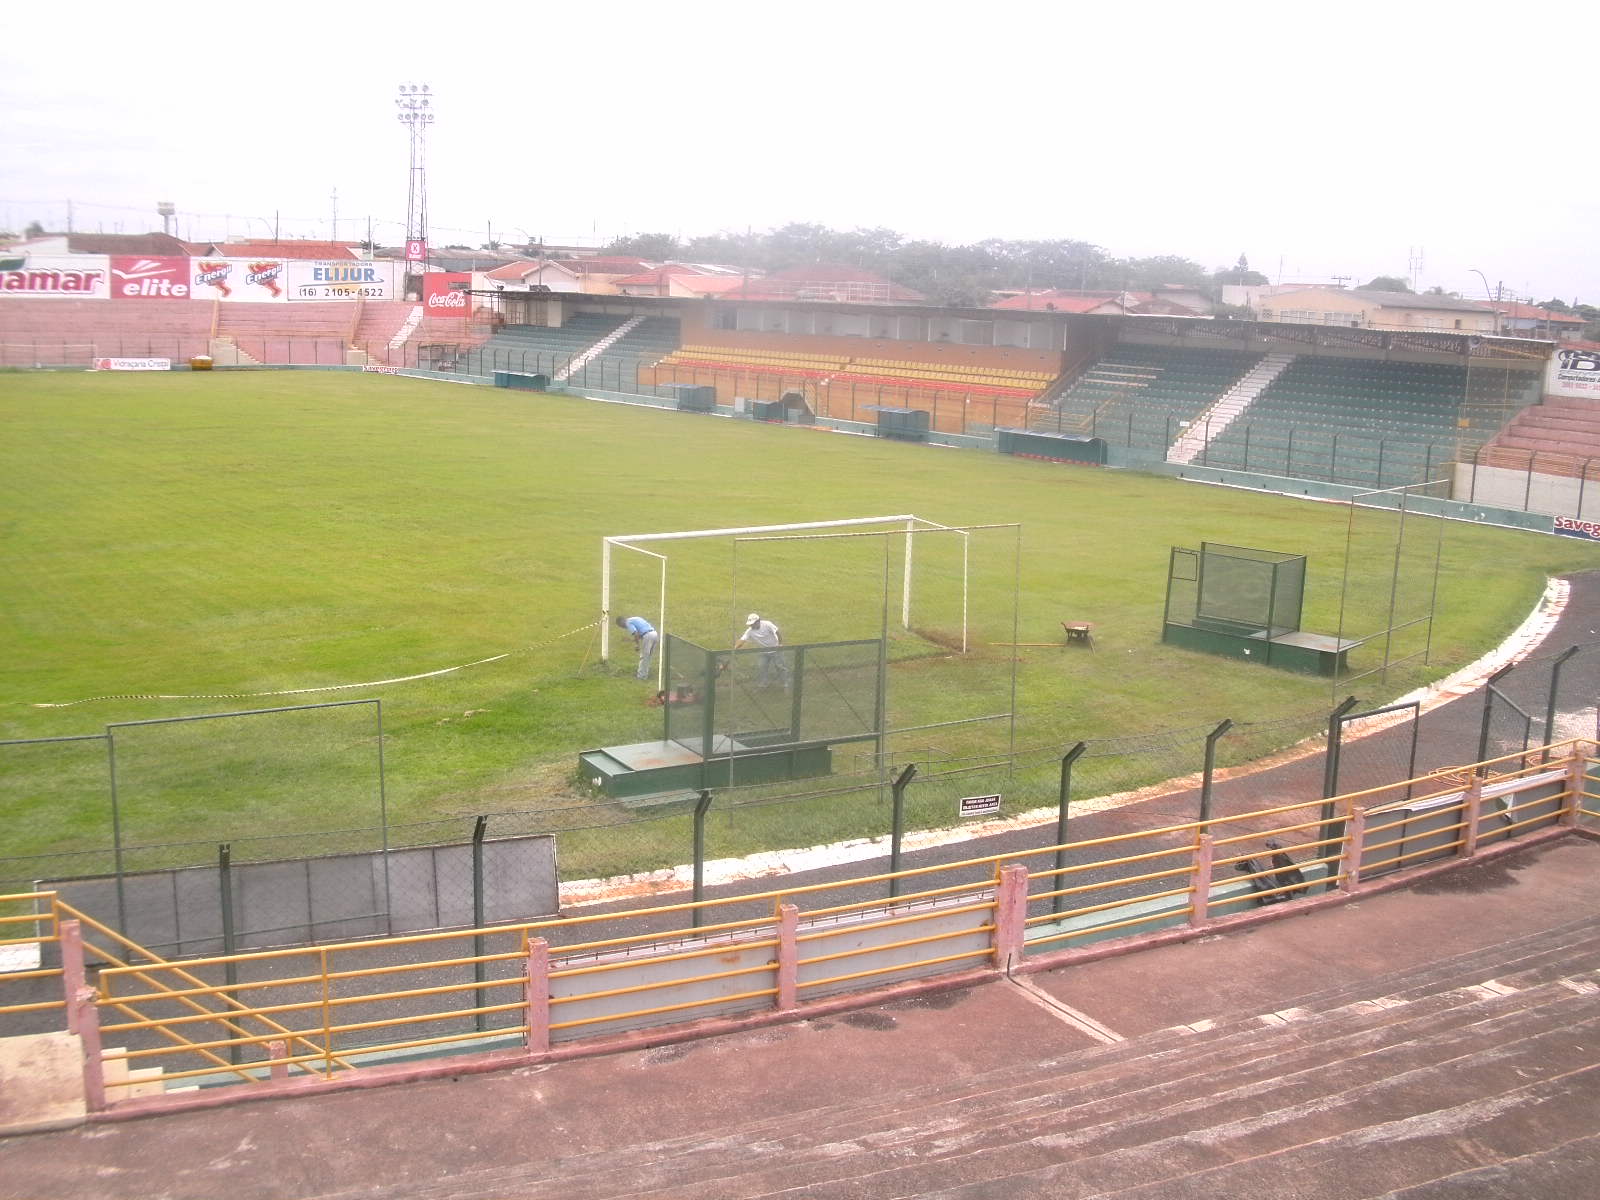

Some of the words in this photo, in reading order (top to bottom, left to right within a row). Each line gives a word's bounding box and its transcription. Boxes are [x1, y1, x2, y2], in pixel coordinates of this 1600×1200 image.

[0, 271, 101, 291] amar
[313, 267, 376, 281] ELIJUR
[122, 278, 188, 297] elite
[299, 287, 317, 297] (16)
[324, 288, 384, 297] 2105-4522
